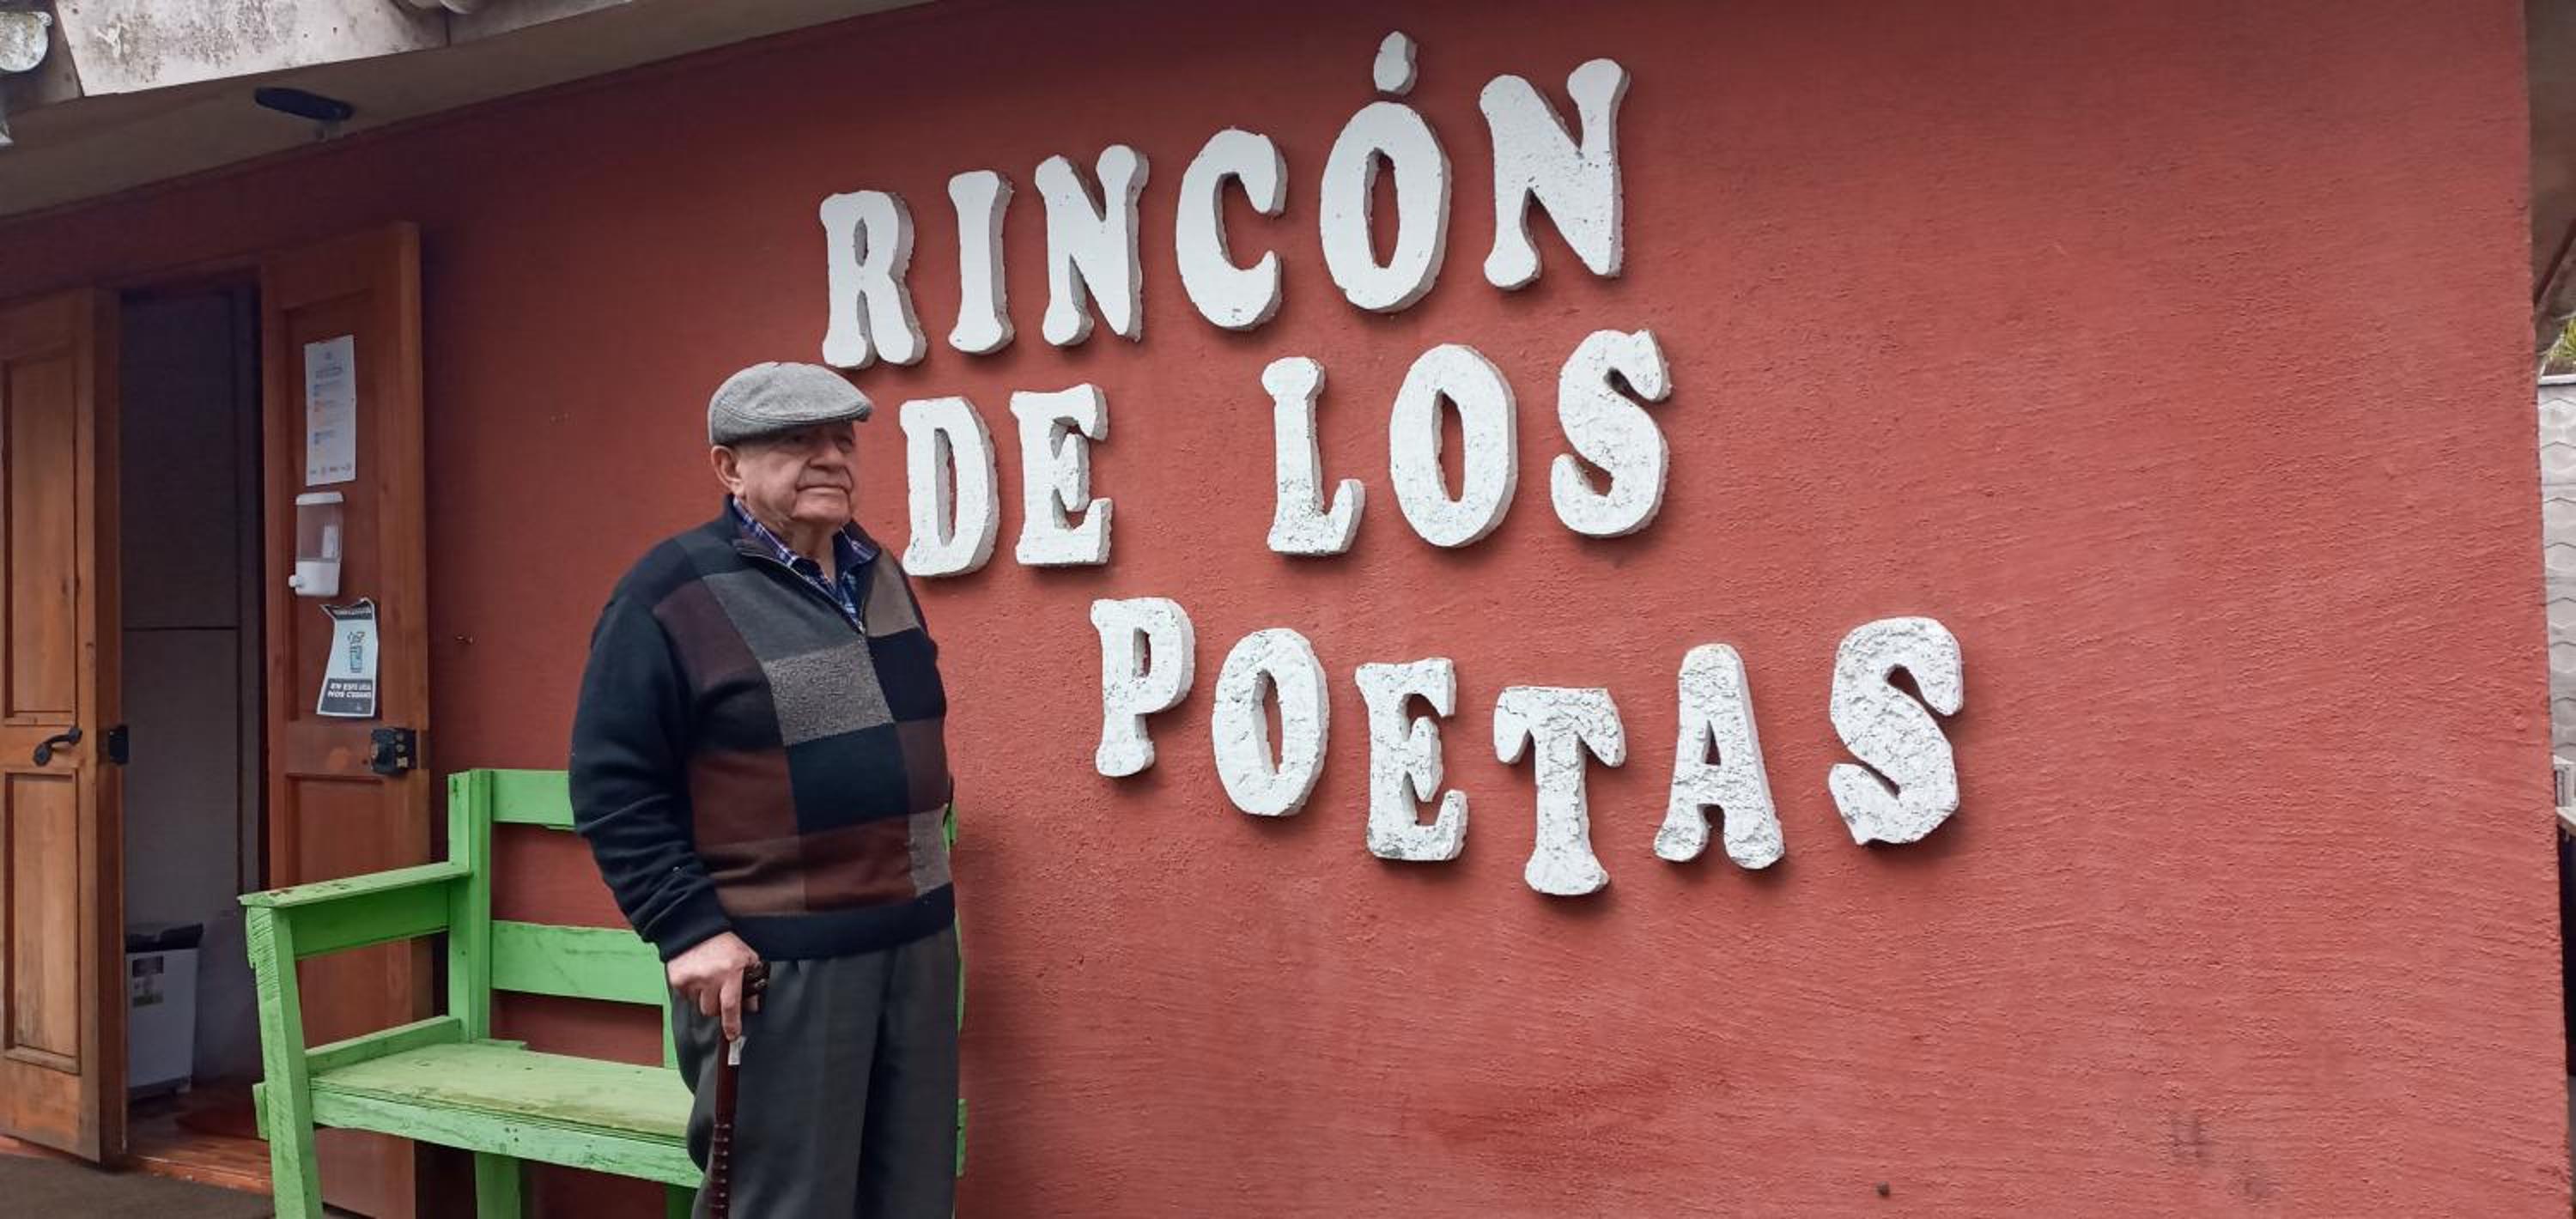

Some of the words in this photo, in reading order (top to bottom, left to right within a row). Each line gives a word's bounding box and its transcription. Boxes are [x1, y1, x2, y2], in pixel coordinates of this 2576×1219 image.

[819, 30, 1631, 369] RINCÓN
[899, 382, 1113, 577] DE
[1261, 329, 1671, 555] LOS
[1090, 596, 1965, 896] POETAS
